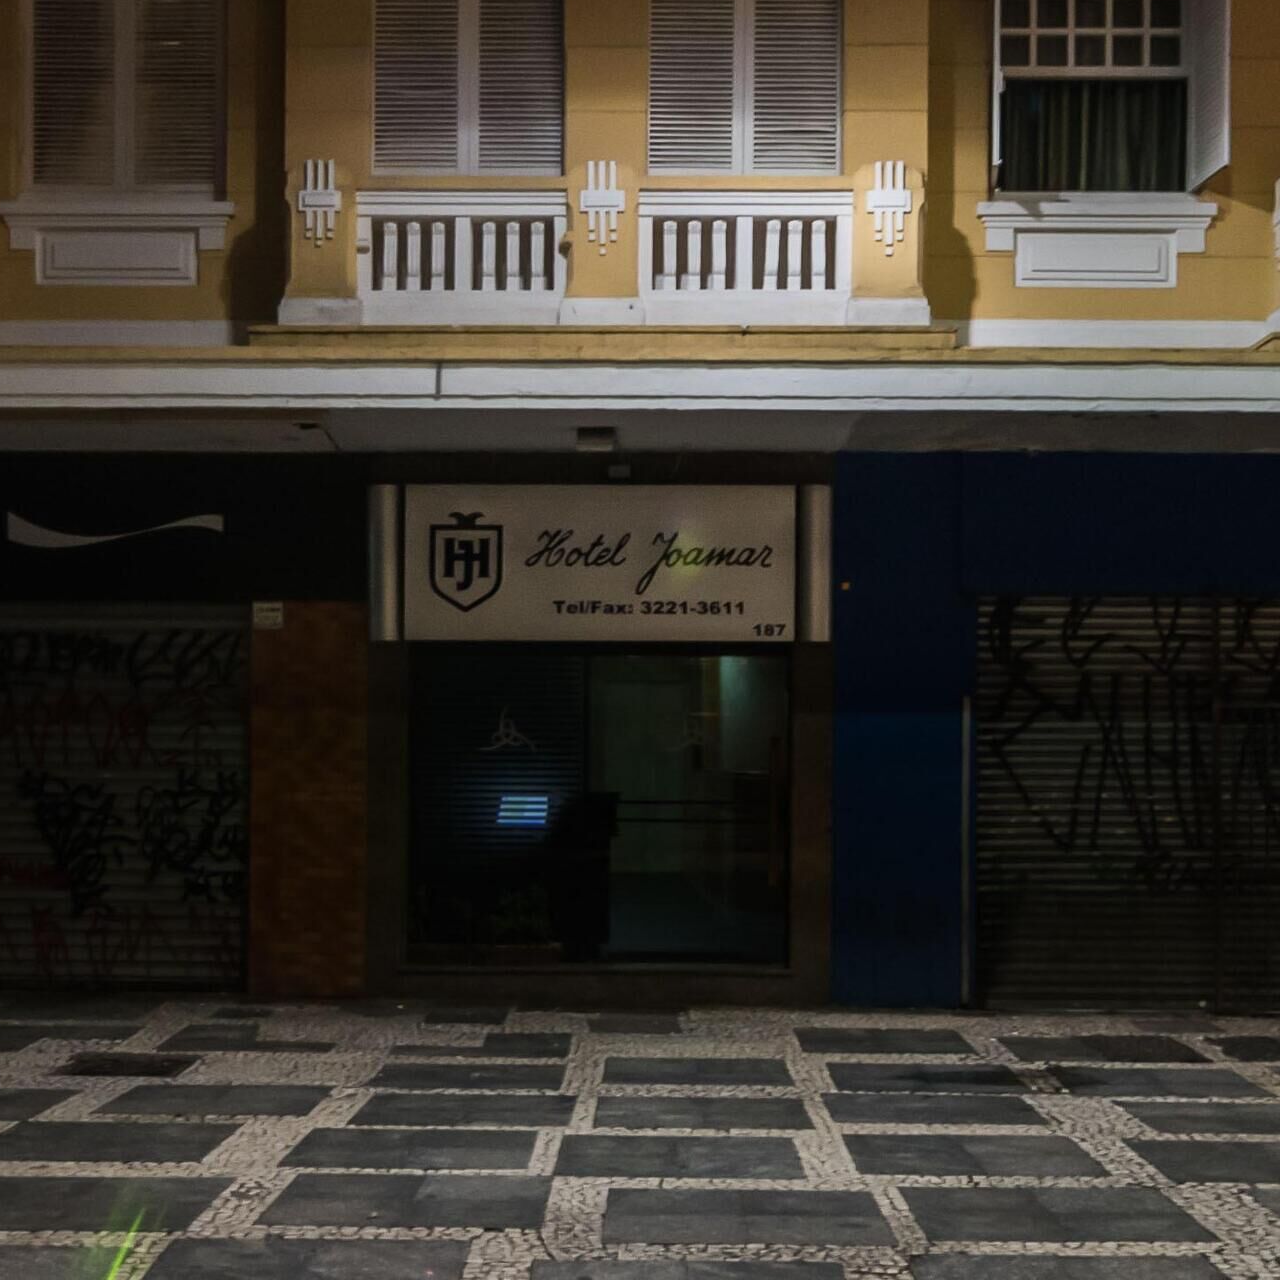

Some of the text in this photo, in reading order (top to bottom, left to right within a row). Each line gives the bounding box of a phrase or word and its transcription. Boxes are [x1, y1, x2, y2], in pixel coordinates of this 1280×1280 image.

[524, 528, 773, 595] Hotel Joamar
[552, 599, 746, 616] Tel/Fax: 3221-3611
[752, 623, 787, 637] 187
